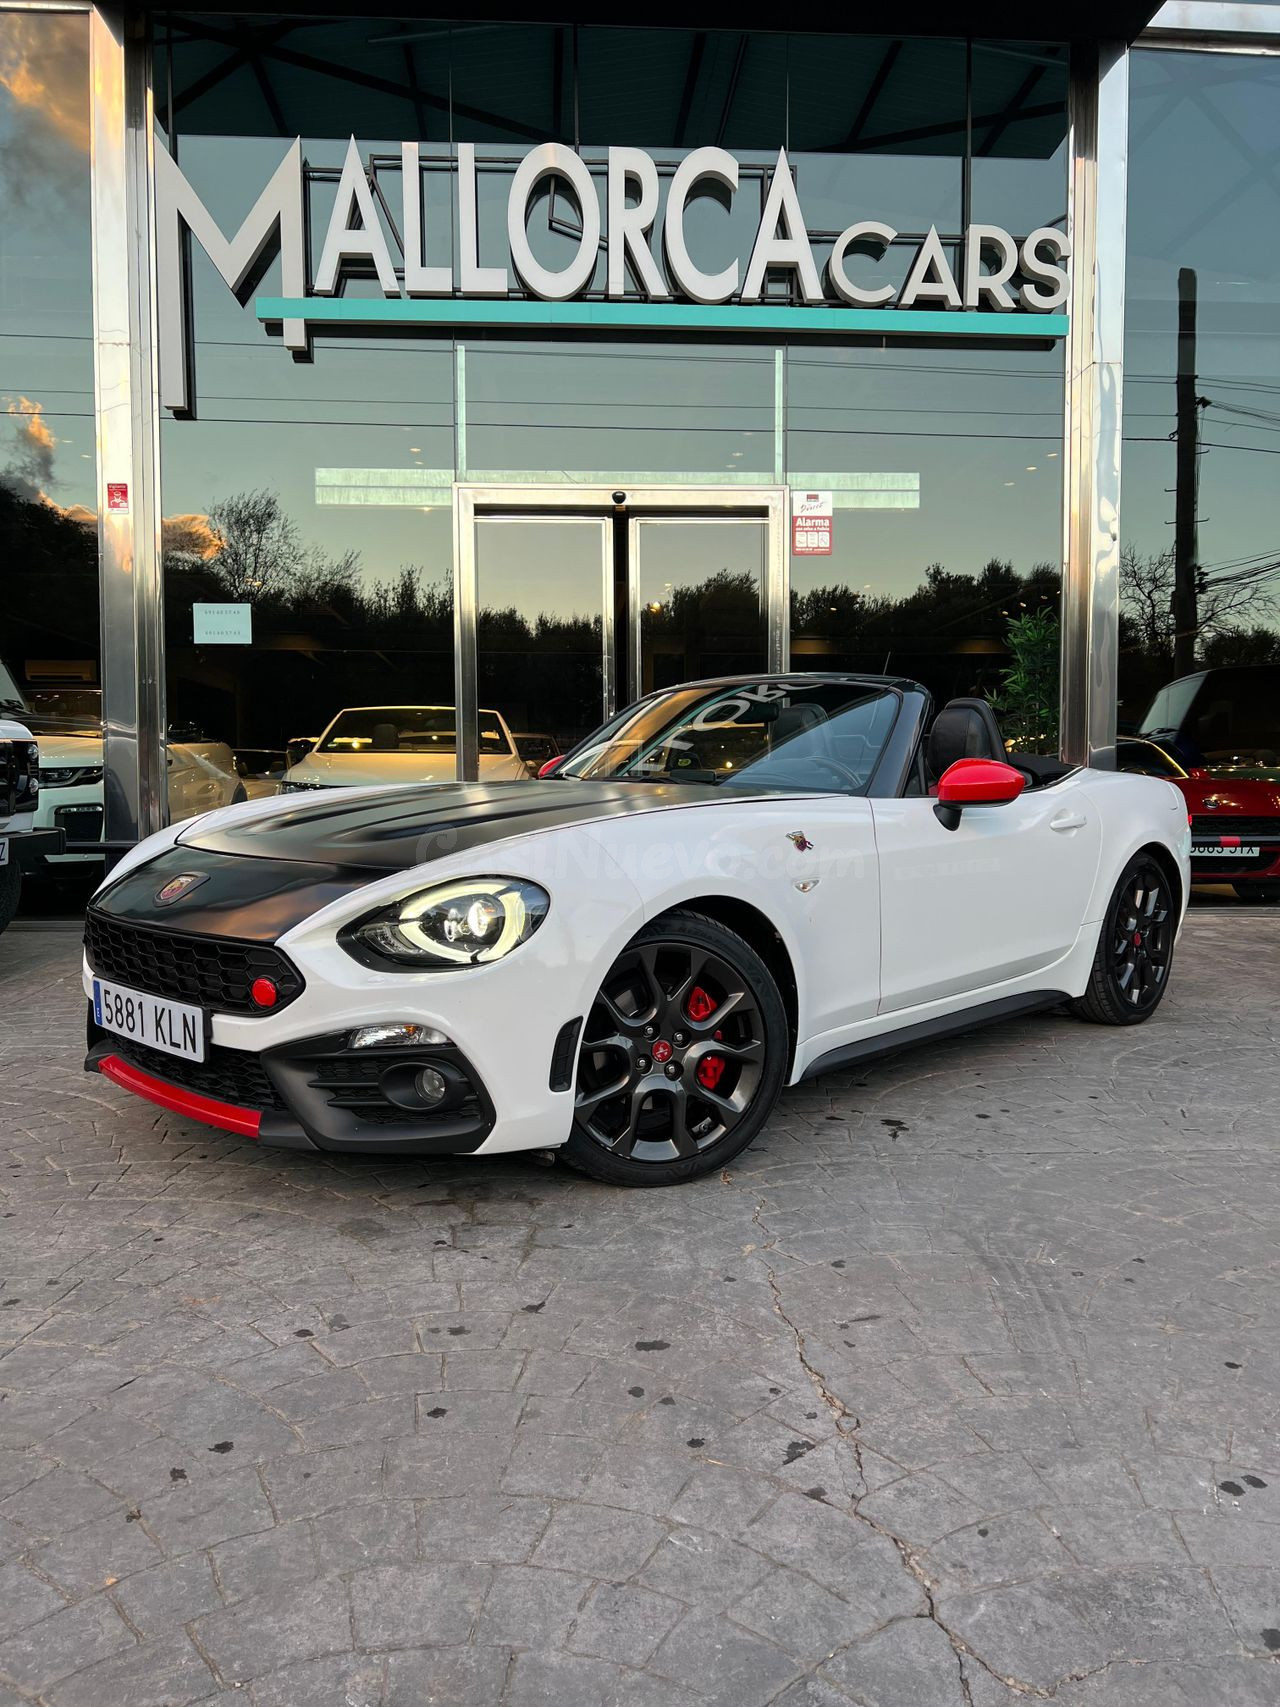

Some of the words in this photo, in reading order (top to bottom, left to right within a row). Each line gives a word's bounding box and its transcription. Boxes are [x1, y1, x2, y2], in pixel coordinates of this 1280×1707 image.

[154, 133, 824, 411] MALLORCA
[828, 220, 1070, 313] CARS
[796, 517, 830, 526] Alarma
[104, 989, 145, 1038] 5881
[154, 1005, 197, 1054] KLN
